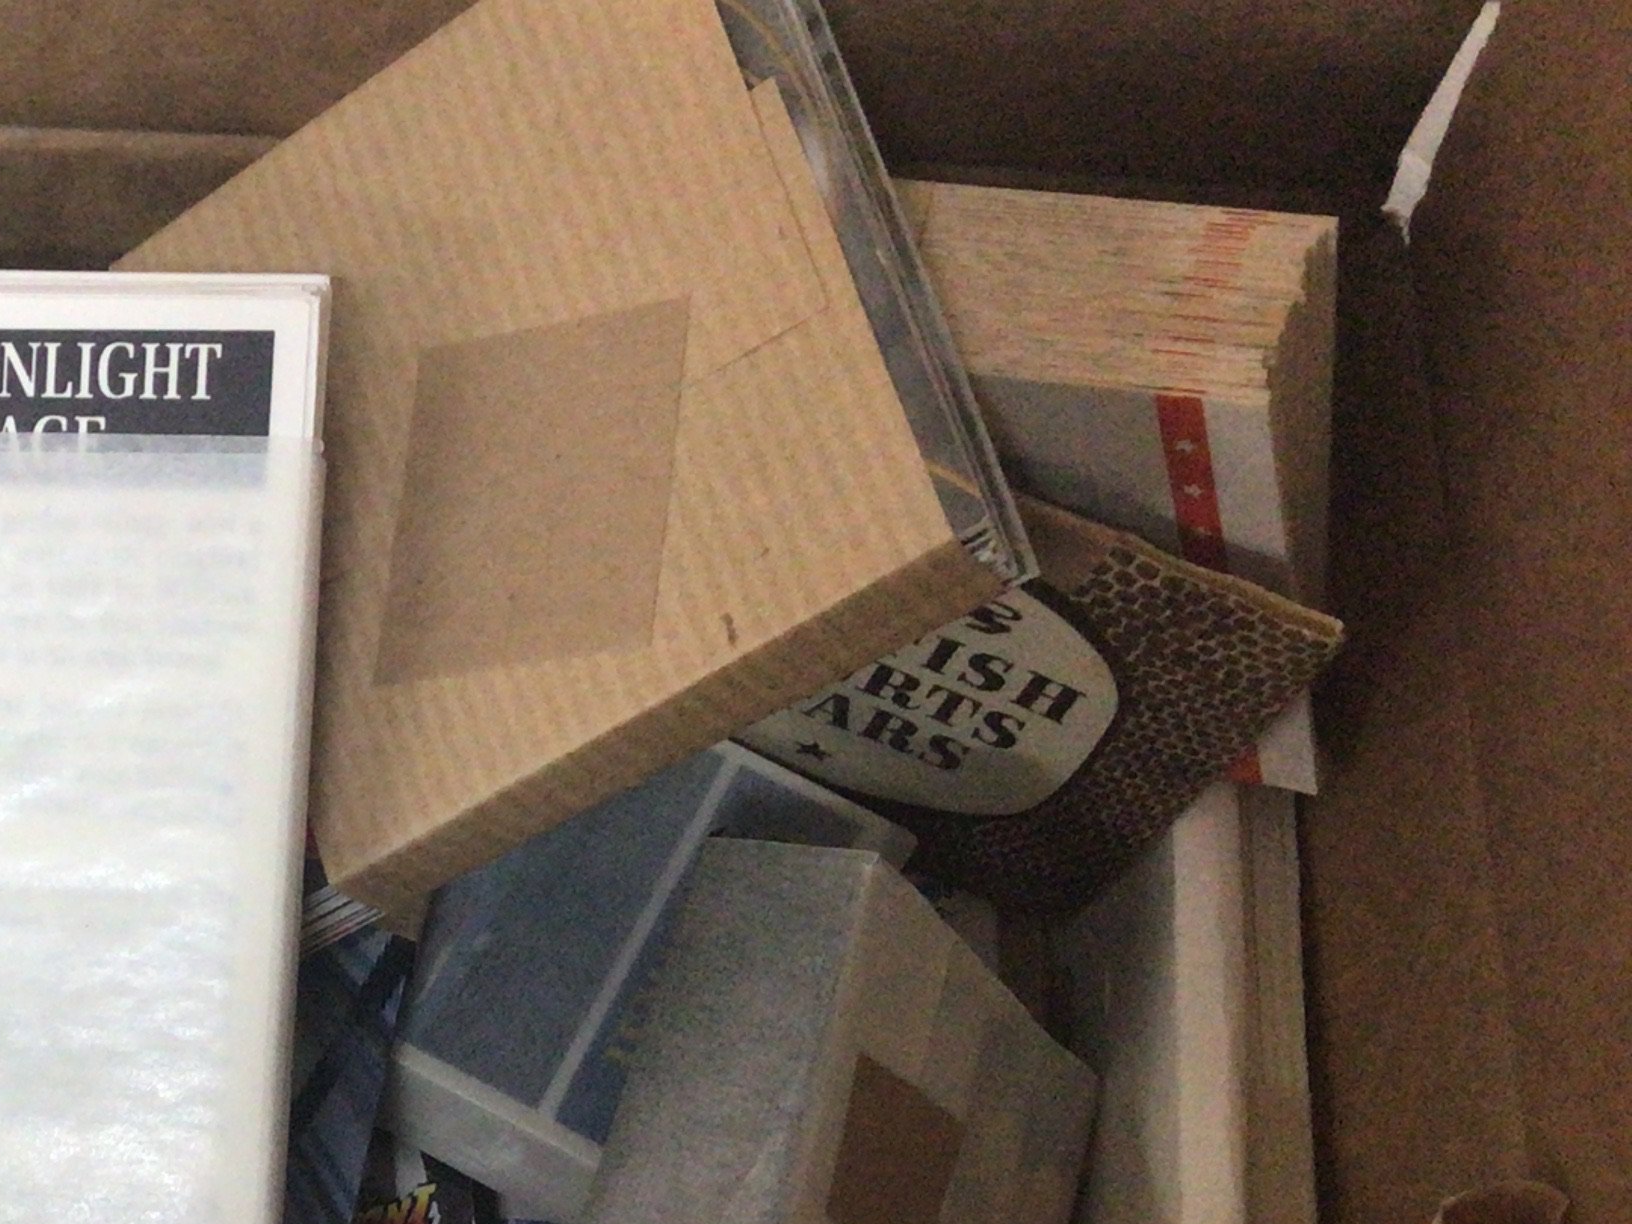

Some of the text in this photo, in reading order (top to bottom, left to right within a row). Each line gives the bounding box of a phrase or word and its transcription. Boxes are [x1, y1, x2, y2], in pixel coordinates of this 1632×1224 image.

[854, 660, 1026, 750] RTS
[921, 634, 1087, 726] ISH
[801, 692, 972, 771] ARS
